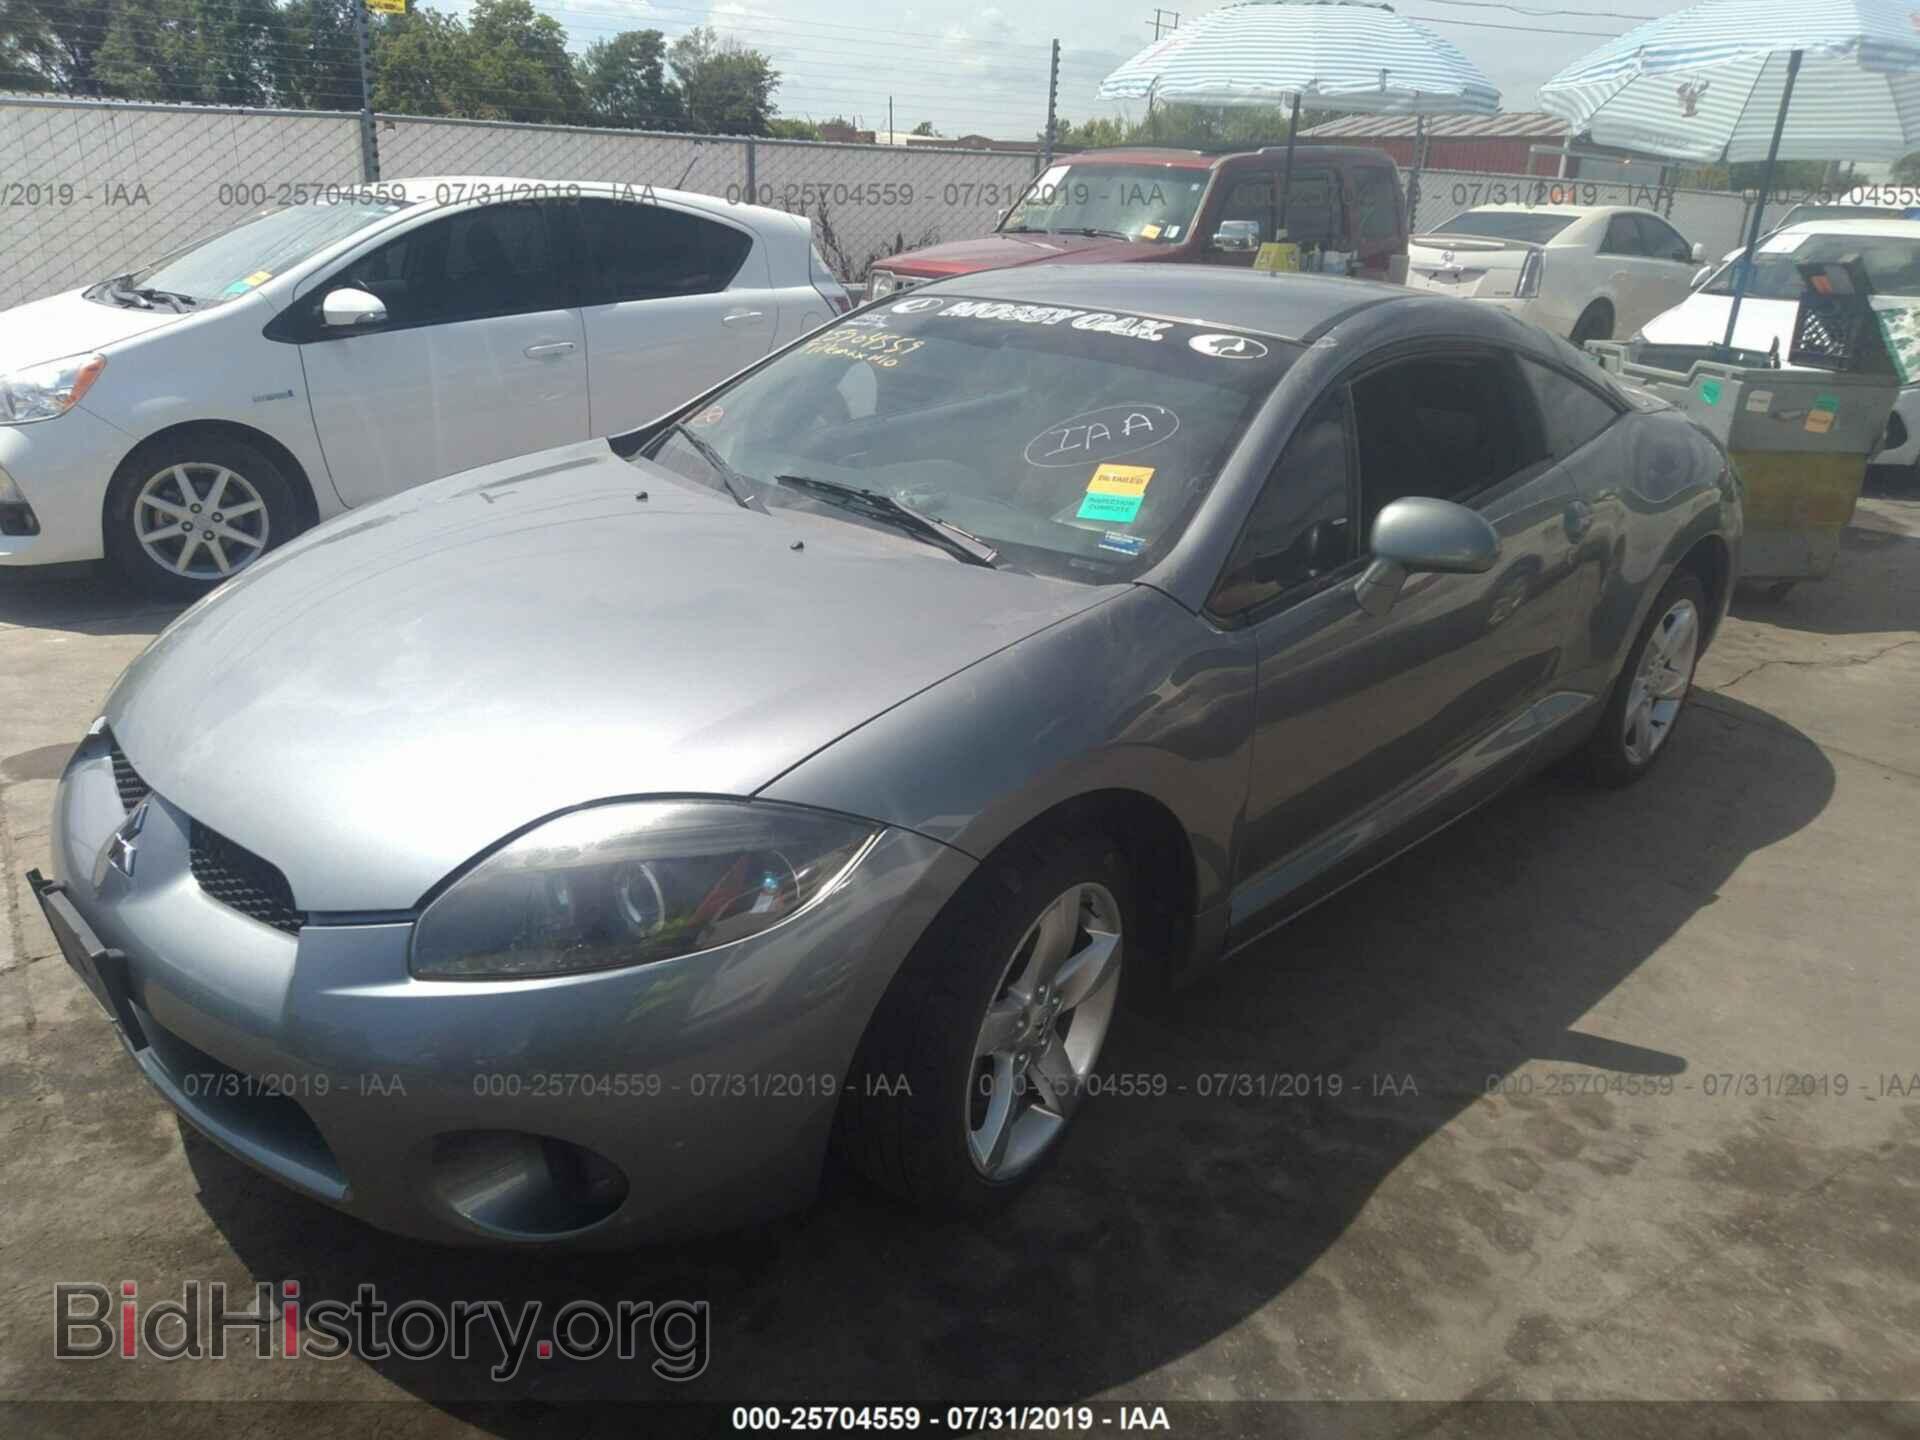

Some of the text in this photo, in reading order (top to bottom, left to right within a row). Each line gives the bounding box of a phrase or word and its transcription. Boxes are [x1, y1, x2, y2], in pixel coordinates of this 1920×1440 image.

[936, 301, 1174, 341] MOSSY OAK
[1044, 412, 1155, 457] IAA
